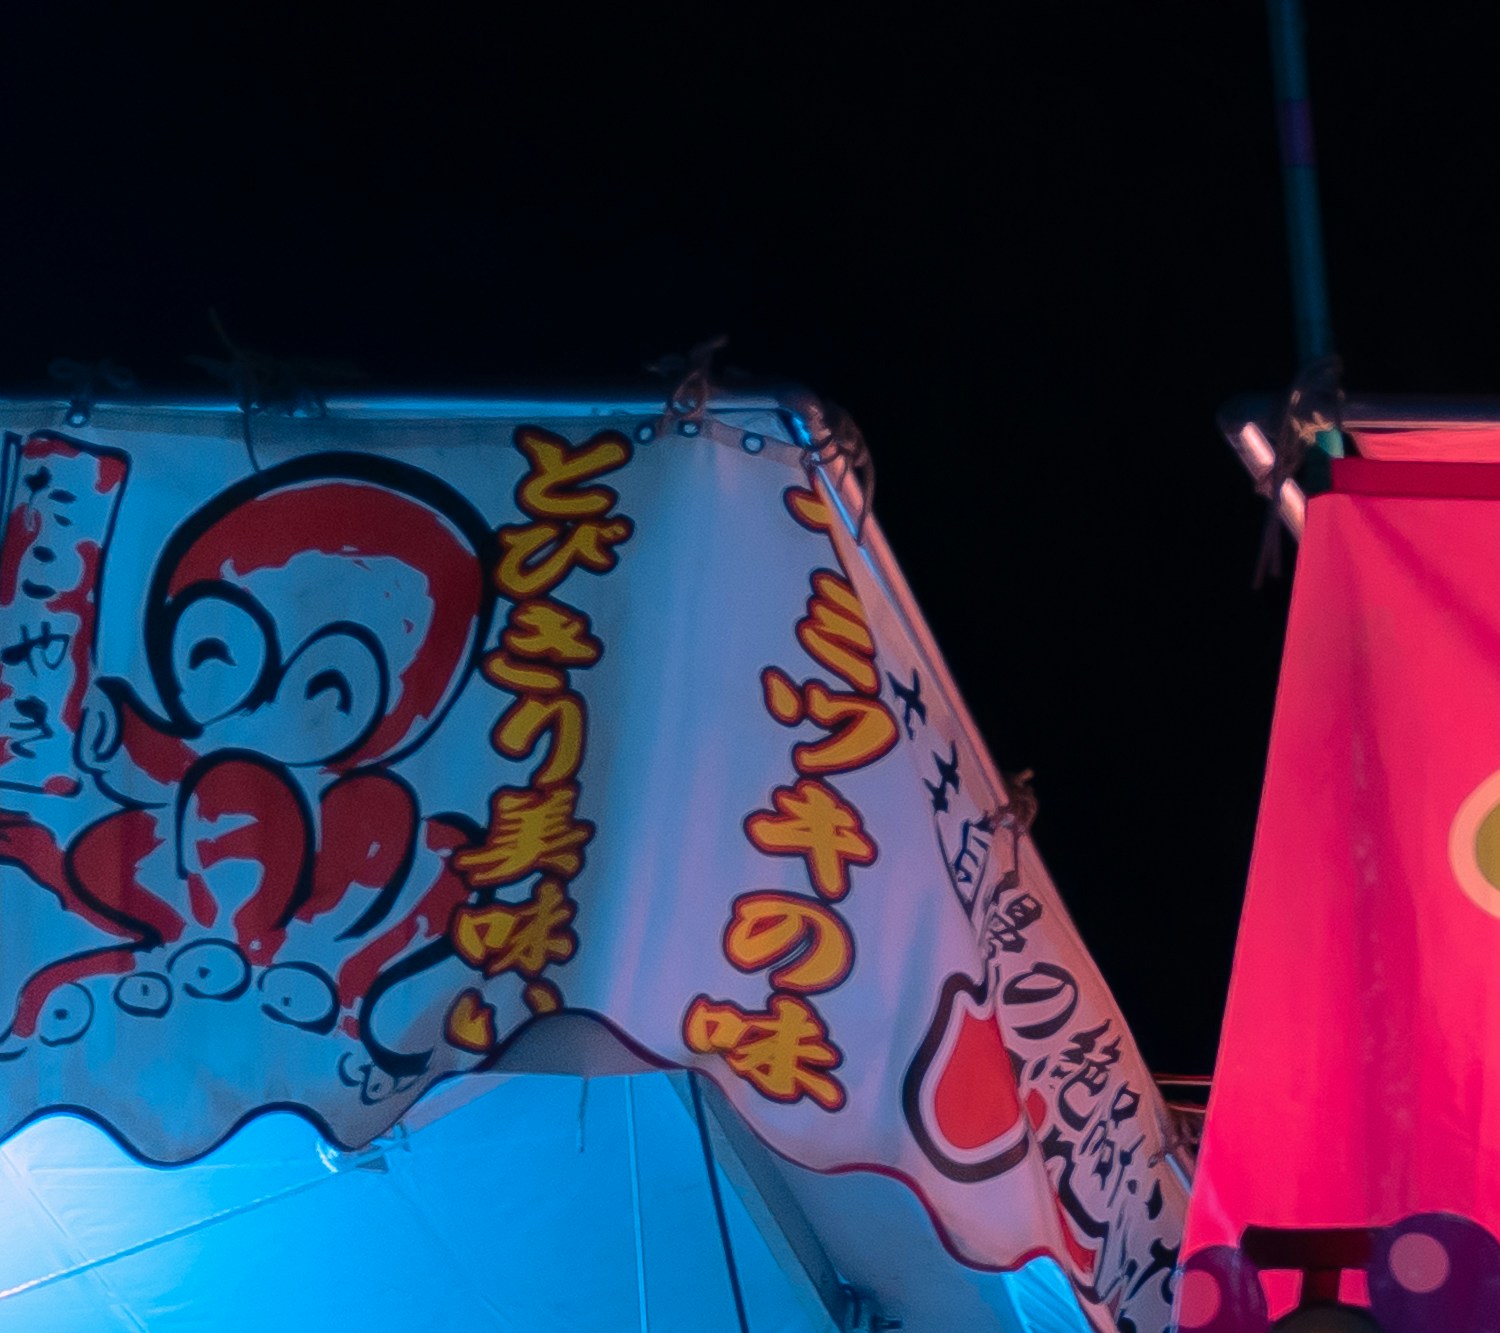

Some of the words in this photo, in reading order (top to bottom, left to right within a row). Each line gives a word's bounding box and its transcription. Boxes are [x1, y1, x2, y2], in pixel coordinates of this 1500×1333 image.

[446, 425, 635, 1053] とびきり美味い
